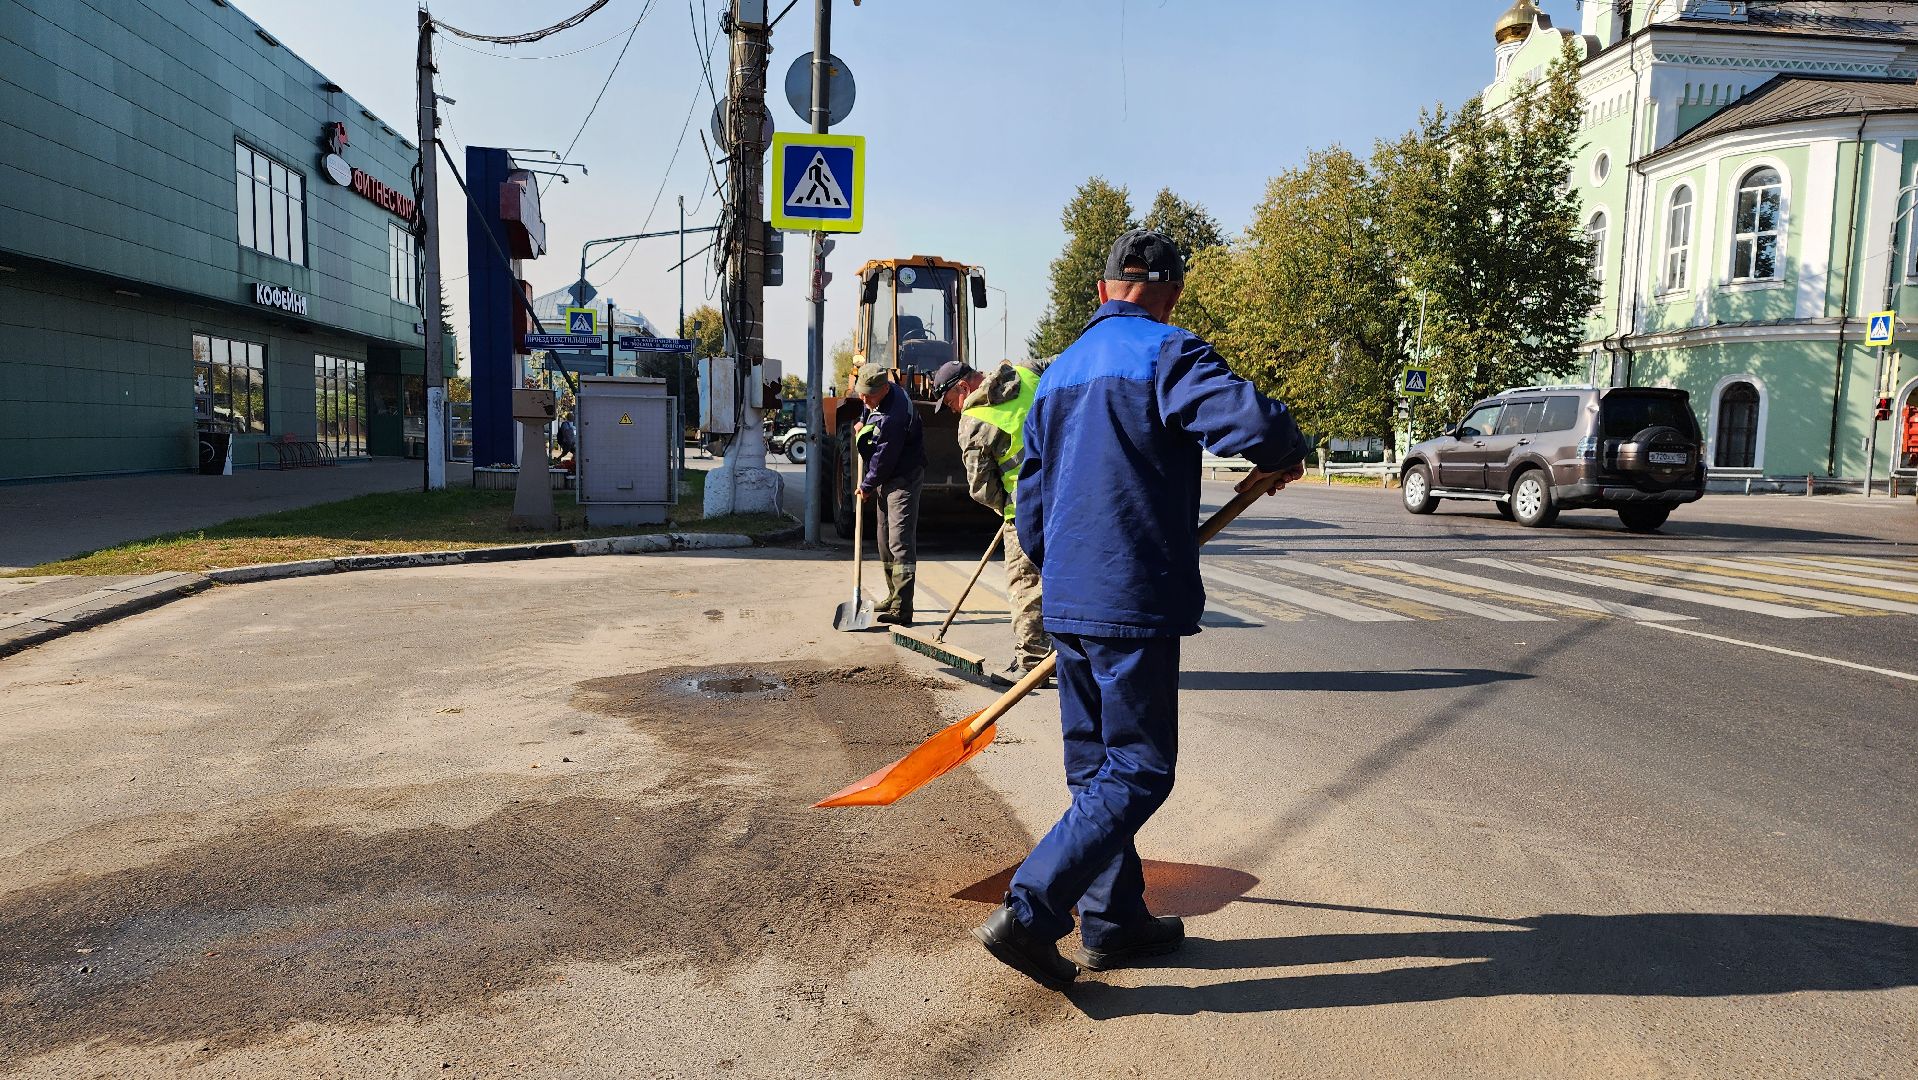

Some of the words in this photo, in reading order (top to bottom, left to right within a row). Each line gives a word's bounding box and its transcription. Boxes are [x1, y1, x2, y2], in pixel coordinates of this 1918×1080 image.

[354, 168, 395, 211] ФИТНЕС
[396, 191, 416, 220] КЛУ
[256, 283, 307, 316] КОФЕЙНЯ
[527, 336, 549, 344] ПРОЕЗД
